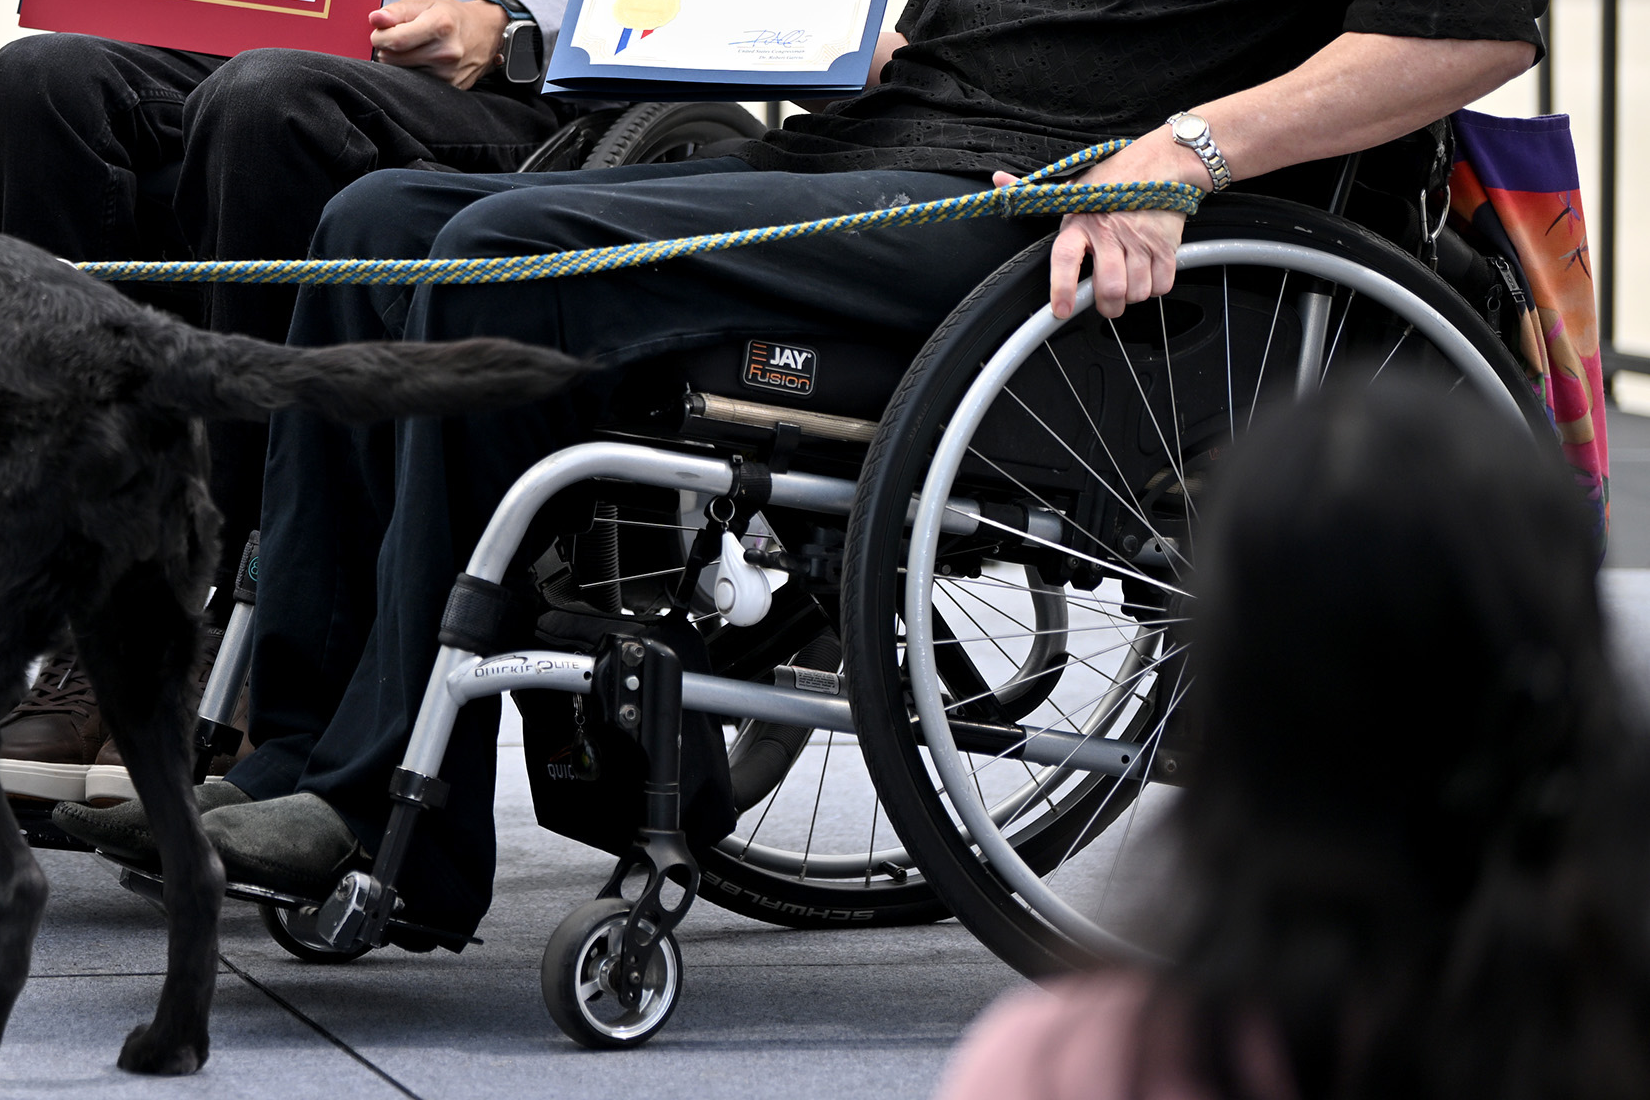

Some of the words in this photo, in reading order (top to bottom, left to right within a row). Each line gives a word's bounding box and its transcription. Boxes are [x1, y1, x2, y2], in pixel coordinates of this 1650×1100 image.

[769, 346, 808, 370] JAY
[748, 363, 810, 392] Fusion
[547, 763, 579, 780] QUIC
[702, 870, 875, 921] SCHWALBE
